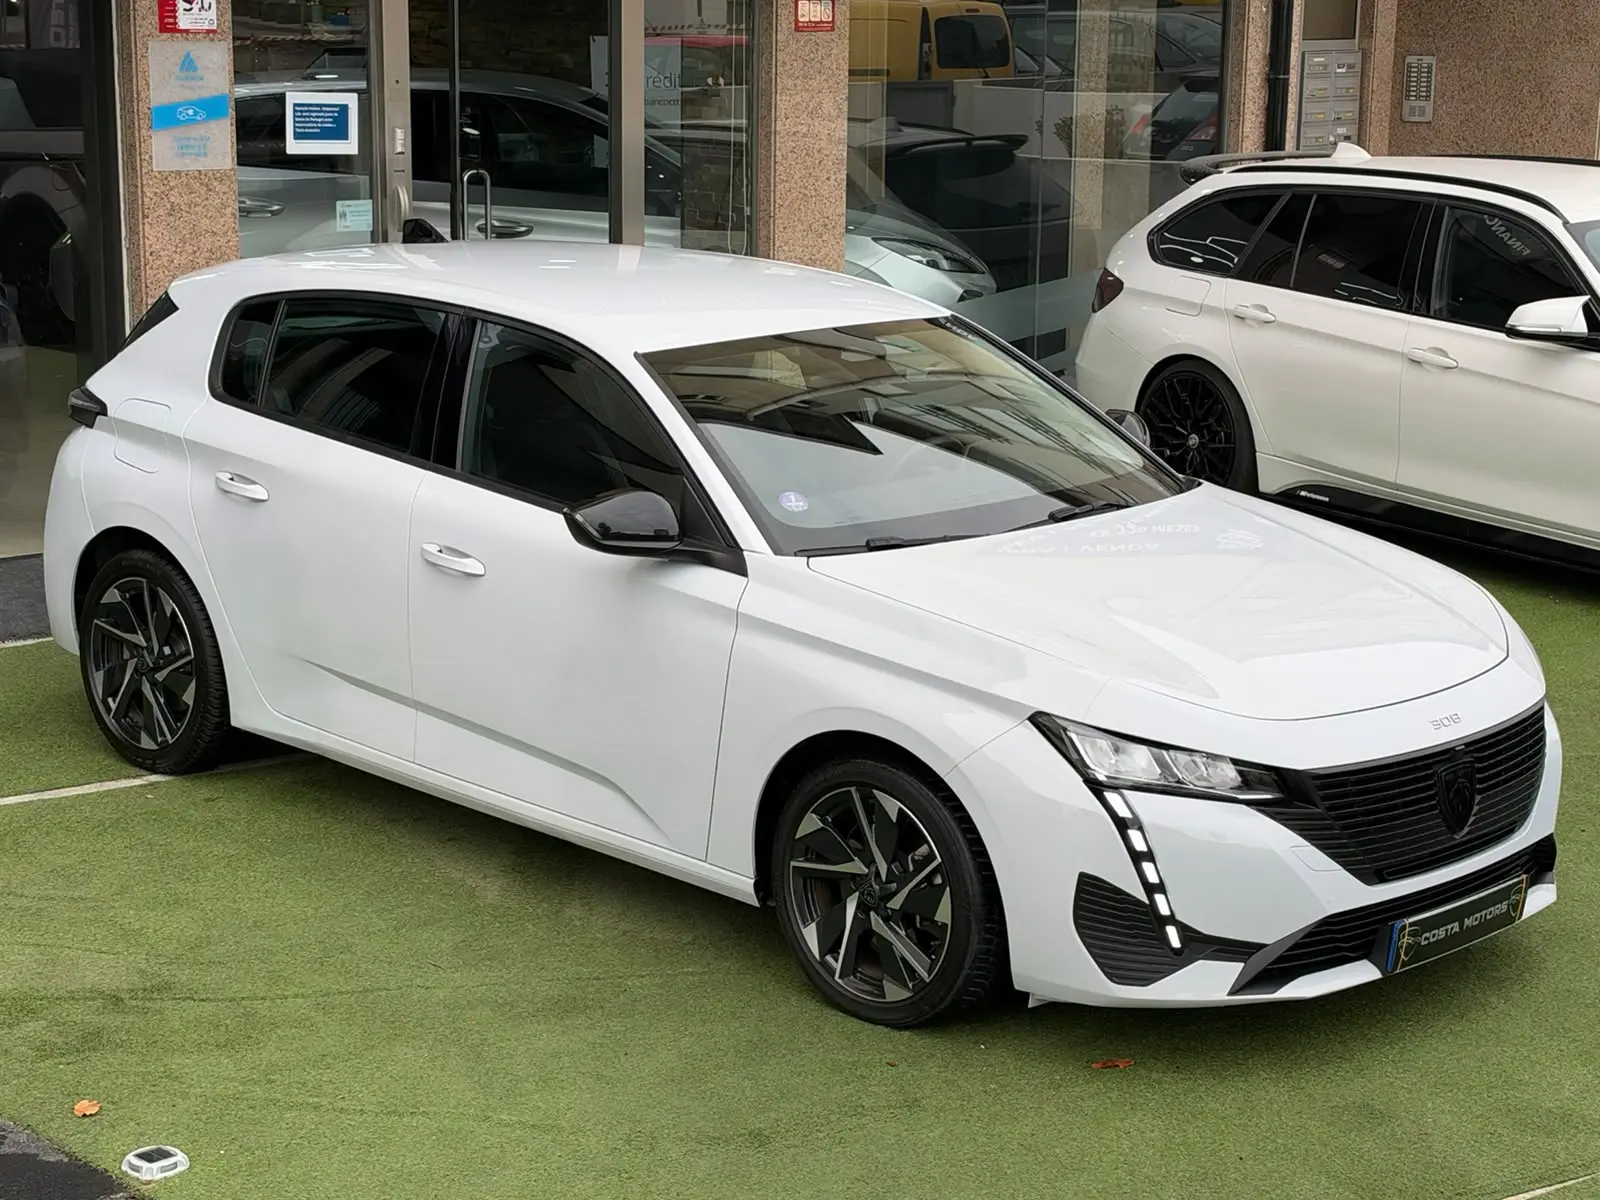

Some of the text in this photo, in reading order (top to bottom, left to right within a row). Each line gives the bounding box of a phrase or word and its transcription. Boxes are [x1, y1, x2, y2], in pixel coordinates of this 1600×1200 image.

[646, 71, 681, 89] rédit
[1428, 712, 1462, 731] 308
[1420, 900, 1509, 946] COSTA MOTORS
